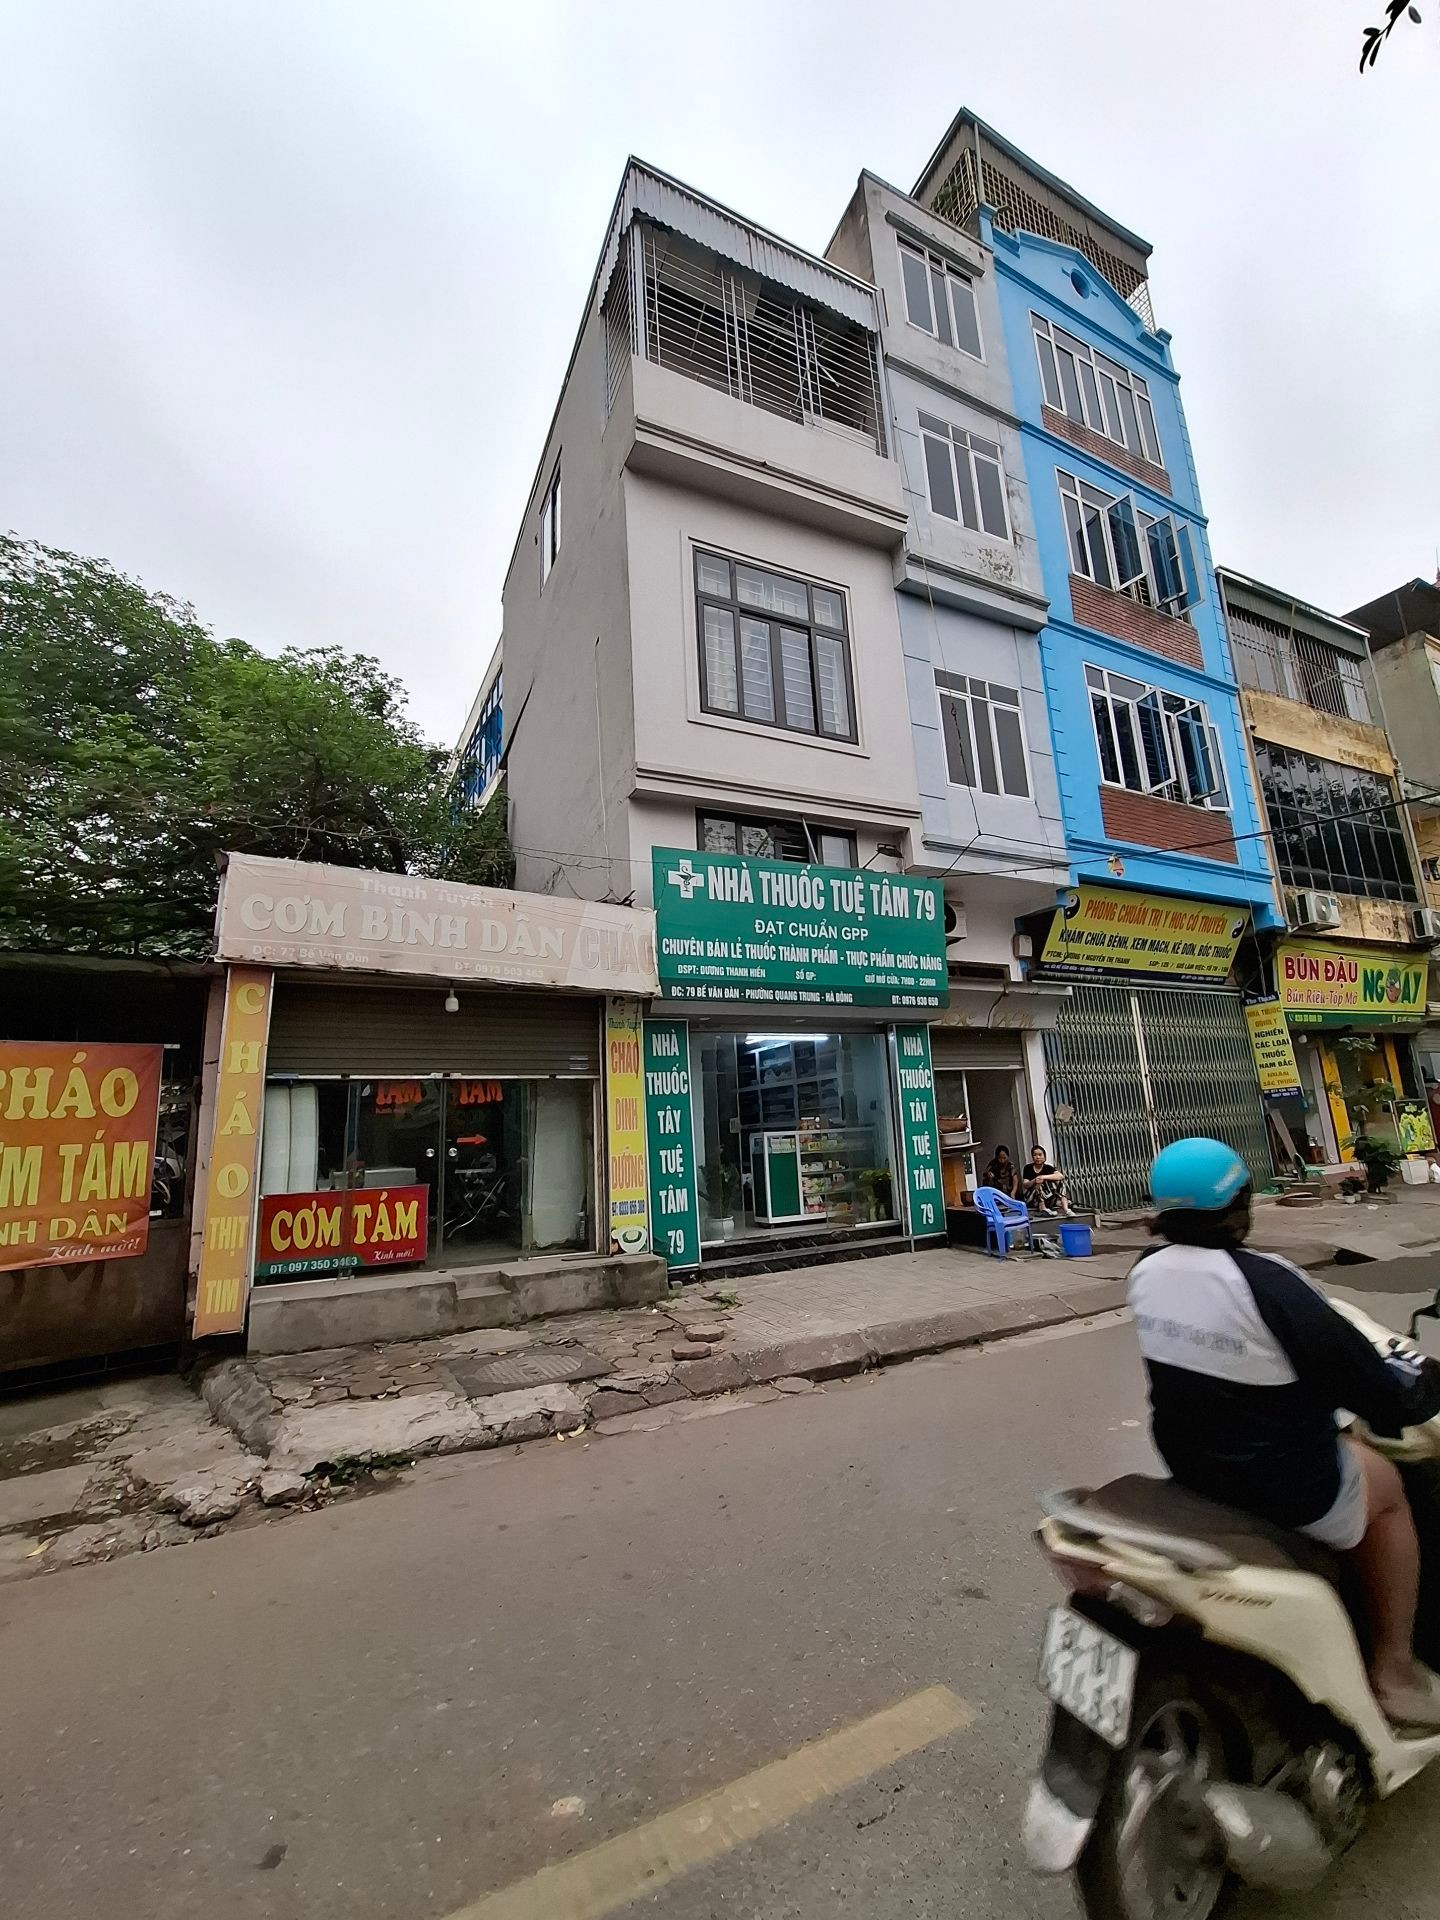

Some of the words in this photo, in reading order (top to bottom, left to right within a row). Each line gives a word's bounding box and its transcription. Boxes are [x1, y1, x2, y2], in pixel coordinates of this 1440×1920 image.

[707, 861, 755, 904] NHÀ
[758, 864, 825, 911] THUỐC
[829, 875, 866, 921] TUỆ
[869, 878, 909, 918] TÂM
[913, 888, 936, 921] 79
[754, 919, 785, 938] ĐẠT
[788, 918, 838, 940] CHUẨN
[841, 926, 869, 941] GPP
[1162, 910, 1172, 929] Y
[240, 893, 348, 938] CƠM
[359, 899, 470, 950] BÌNH
[480, 913, 565, 960] DÂN
[579, 923, 657, 975] CHÁO
[1129, 937, 1150, 951] XEM
[662, 936, 705, 957] CHUYÊN
[706, 938, 730, 958] BÁN
[731, 936, 743, 959] LẺ
[744, 939, 777, 961] THUỐC
[778, 944, 811, 963] THÀNH
[811, 943, 839, 965] PHẨM
[845, 949, 869, 969] THỰC
[870, 947, 895, 968] PHẨM
[896, 950, 919, 970] CHỨC
[919, 953, 943, 971] NĂNG
[677, 964, 699, 975] DSPT:
[726, 966, 749, 977] THANH
[1284, 953, 1320, 981] BÚN
[1324, 955, 1358, 988] ĐẬU
[671, 985, 685, 997] ĐC:
[685, 986, 696, 998] 79
[696, 983, 707, 998] BẾ
[707, 985, 723, 999] VĂN
[724, 986, 740, 999] ĐÀN
[745, 986, 774, 1001] PHƯỜNG
[774, 990, 798, 1002] QUANG
[799, 991, 821, 1003] TRUNG
[1286, 988, 1304, 1003] Bún
[611, 1035, 640, 1075] CHÁO
[652, 1029, 679, 1057] NHÀ
[903, 1033, 924, 1056] NHÀ
[0, 1051, 139, 1120] HÁO
[646, 1064, 688, 1095] THUỐC
[900, 1062, 931, 1089] THUỐC
[615, 1097, 638, 1132] DINH
[657, 1105, 681, 1134] TÂY
[909, 1098, 927, 1122] TÂY
[912, 1131, 931, 1159] TUỆ
[59, 1130, 149, 1203] TÁM
[611, 1146, 644, 1191] DƯỠNG
[659, 1145, 684, 1177] TUỆ
[913, 1165, 935, 1190] TÂM
[659, 1188, 688, 1214] TÂM
[920, 1204, 934, 1225] 79
[49, 1209, 128, 1240] DÂN
[270, 1200, 342, 1252] CƠM
[352, 1191, 419, 1244] TÁM
[209, 1215, 249, 1257] THỊT
[667, 1230, 684, 1254] 79
[49, 1243, 94, 1259] Kính
[288, 1261, 308, 1272] 097
[310, 1259, 330, 1270] 350
[205, 1278, 240, 1314] TIM
